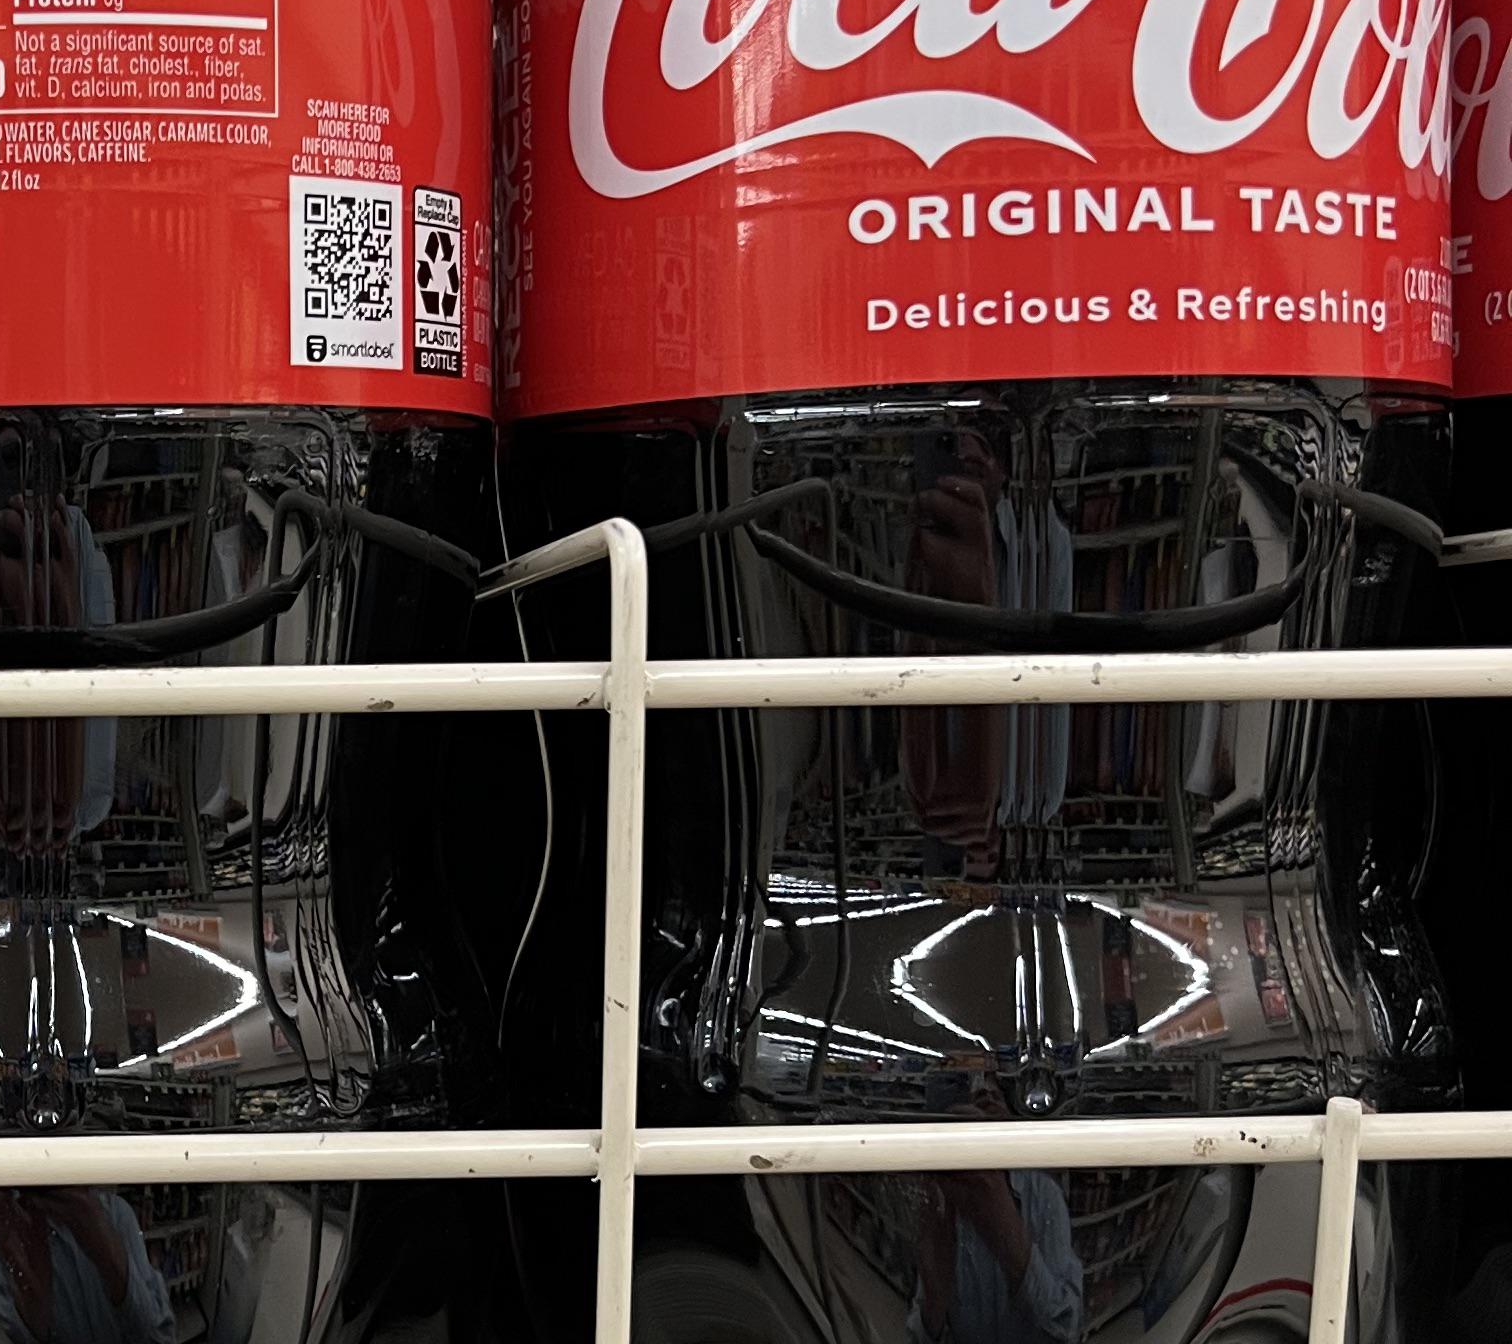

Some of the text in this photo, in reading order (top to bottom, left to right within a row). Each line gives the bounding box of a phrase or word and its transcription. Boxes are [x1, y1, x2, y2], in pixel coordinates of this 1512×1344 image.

[15, 30, 267, 57] Not significant source of sat.
[49, 53, 92, 75] trans
[148, 76, 181, 99] iron
[185, 77, 215, 99] and
[307, 98, 390, 125] SCAN HERE FOR
[62, 121, 100, 142] CANE
[103, 121, 156, 145] SUGAR,
[158, 122, 224, 143] CARAMEL
[226, 123, 272, 148] COLOR,
[318, 119, 381, 143] MORE FOOD
[78, 142, 153, 164] CAFFEINE.
[302, 137, 378, 162] INFORMATION
[292, 154, 322, 176] CALL
[521, 52, 534, 291] SEE YOU AGAIN
[848, 186, 1397, 244] ORIGINAL TASTE
[867, 292, 1110, 332] Delicious
[1128, 288, 1157, 321] &
[1177, 288, 1387, 333] Refreshing
[419, 327, 459, 349] PLASTIC
[420, 351, 458, 372] BOTTLE
